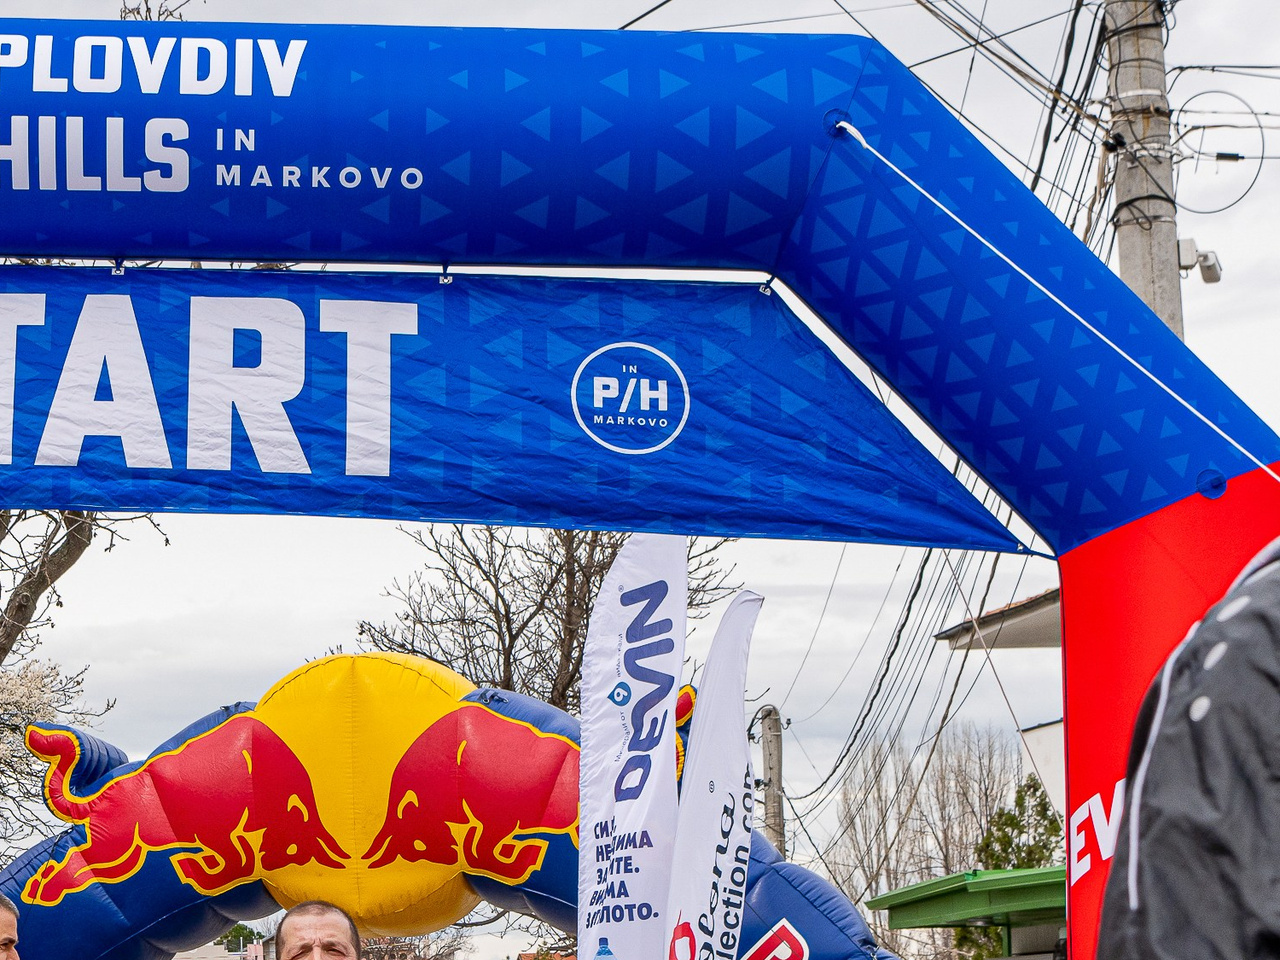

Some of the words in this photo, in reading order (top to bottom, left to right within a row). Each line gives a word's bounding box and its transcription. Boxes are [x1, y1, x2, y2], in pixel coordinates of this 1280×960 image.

[216, 128, 256, 152] IN
[216, 164, 425, 190] MARKOVO
[622, 365, 638, 374] IN
[593, 376, 668, 412] P/H
[593, 415, 668, 428] MARKOVO
